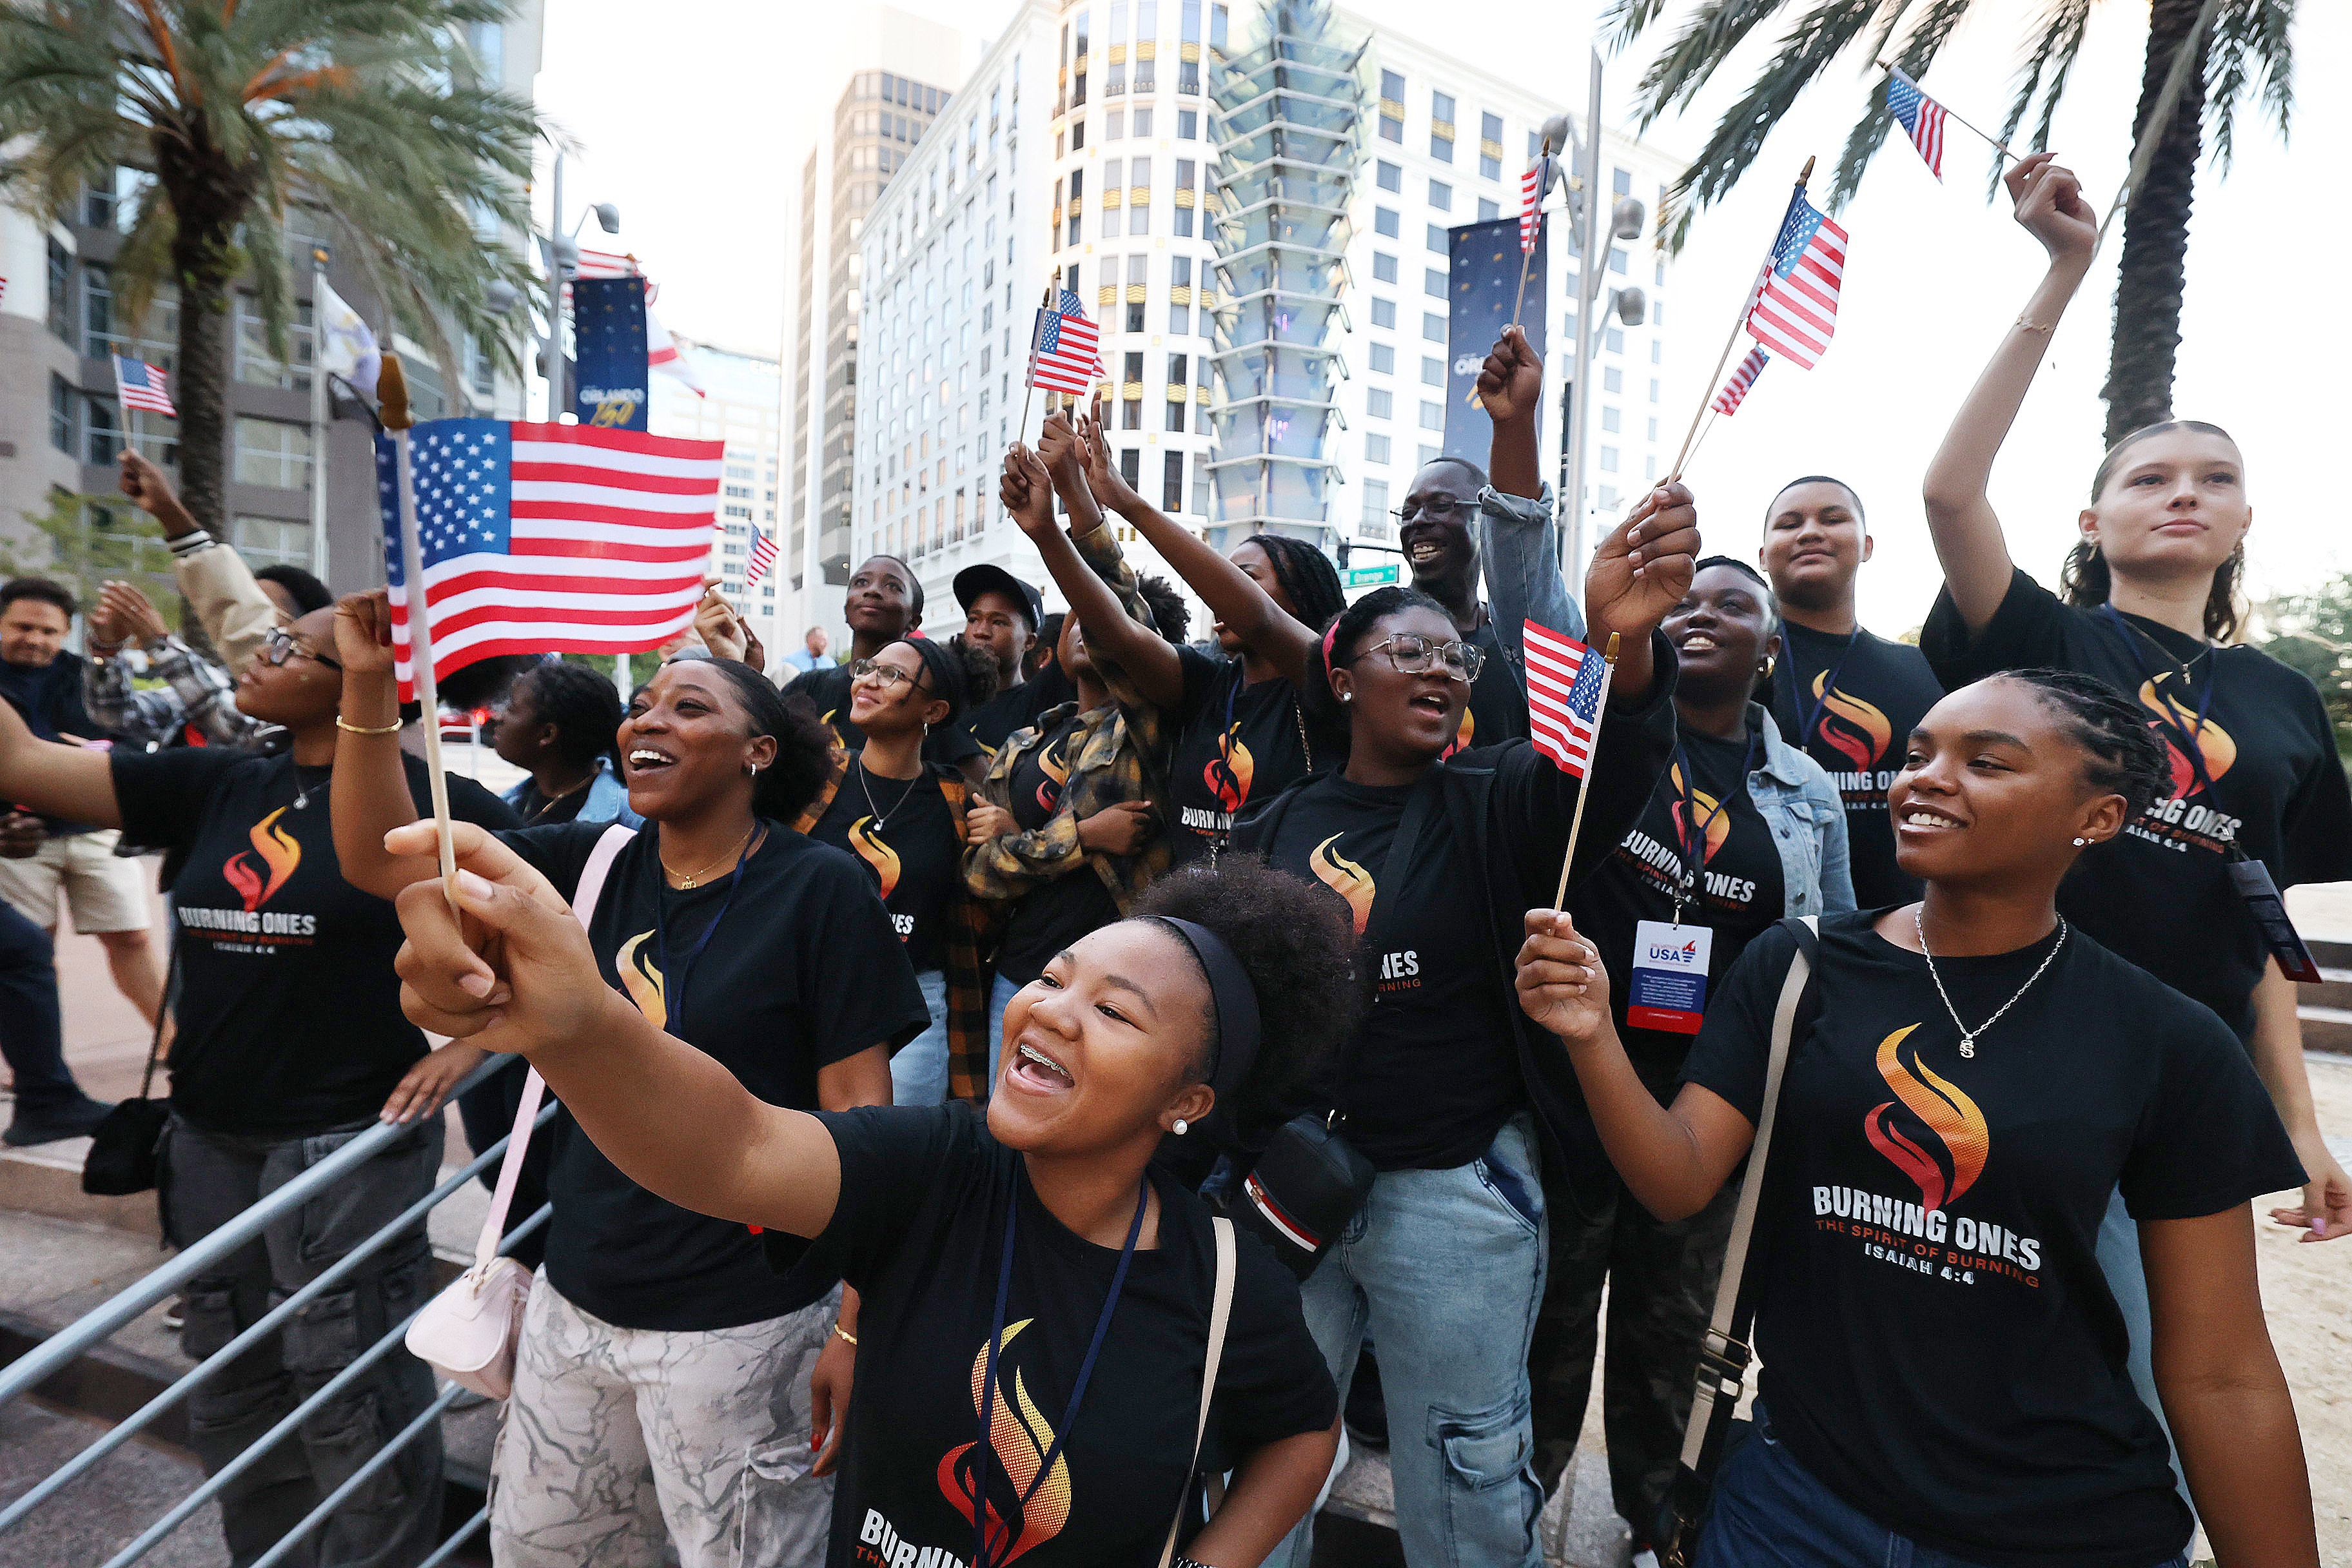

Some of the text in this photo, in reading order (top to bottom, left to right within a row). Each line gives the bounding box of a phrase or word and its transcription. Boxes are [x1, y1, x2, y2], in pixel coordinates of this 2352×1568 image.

[1355, 571, 1384, 583] Orange
[1181, 806, 1235, 830] BURNIN
[262, 912, 317, 935] ONES
[1380, 950, 1419, 979] NES
[1650, 948, 1680, 961] USA
[1378, 978, 1422, 992] RNING
[1812, 1185, 2041, 1271] BURNING ONES
[1815, 1219, 2040, 1288] THE SPIRIT OF BURNING
[1865, 1242, 1975, 1285] ISAIAH 4:4
